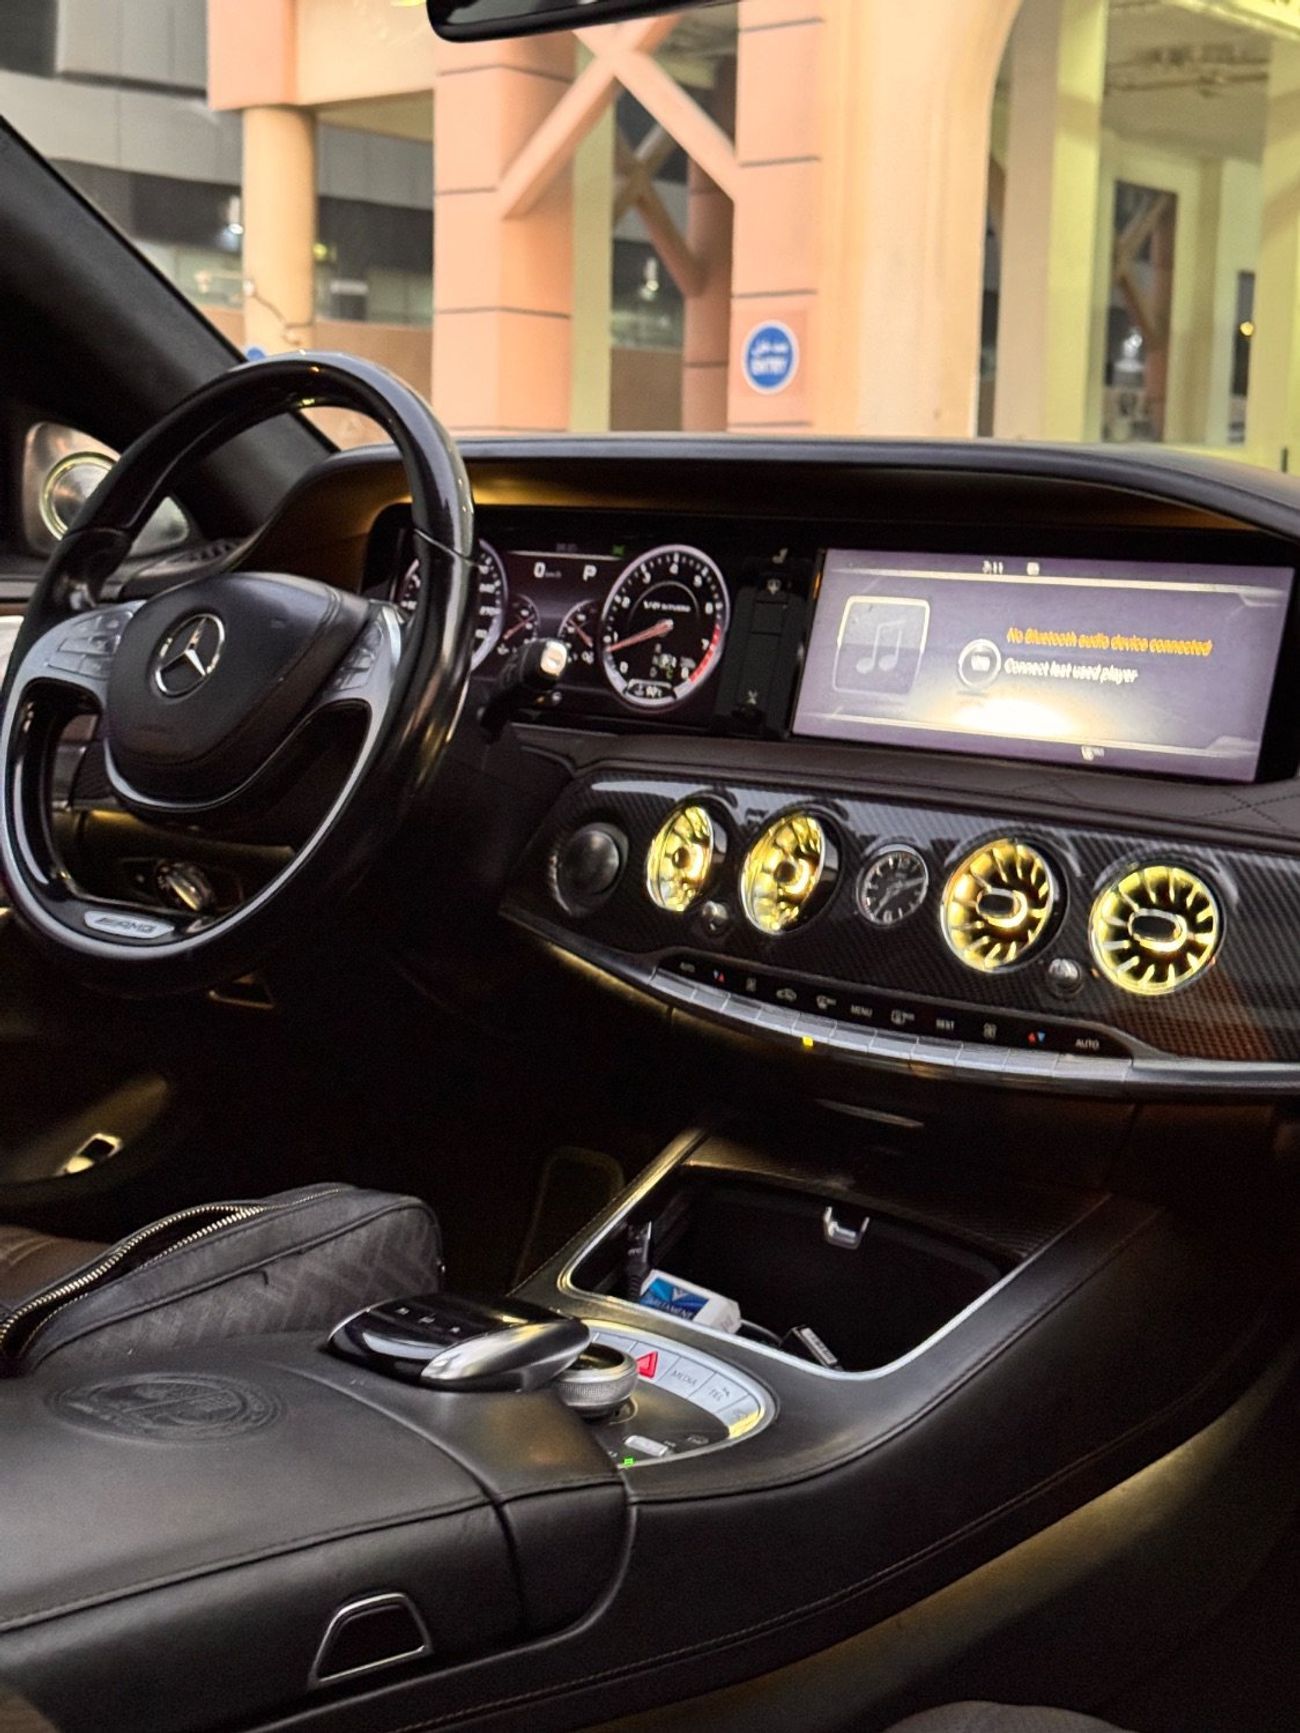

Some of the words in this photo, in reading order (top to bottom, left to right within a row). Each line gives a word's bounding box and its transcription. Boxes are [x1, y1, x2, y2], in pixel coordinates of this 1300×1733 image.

[583, 564, 597, 582] P
[1007, 627, 1024, 644] No
[1024, 627, 1077, 647] Bluetooth
[1078, 632, 1110, 650] audio
[1110, 633, 1149, 652] device
[1149, 637, 1213, 657] connected
[1004, 657, 1050, 677] Connect
[1049, 660, 1072, 680] last
[1072, 665, 1101, 682] used
[1100, 664, 1139, 685] player
[1075, 1037, 1100, 1050] AUTO
[670, 1369, 698, 1387] MEDIA
